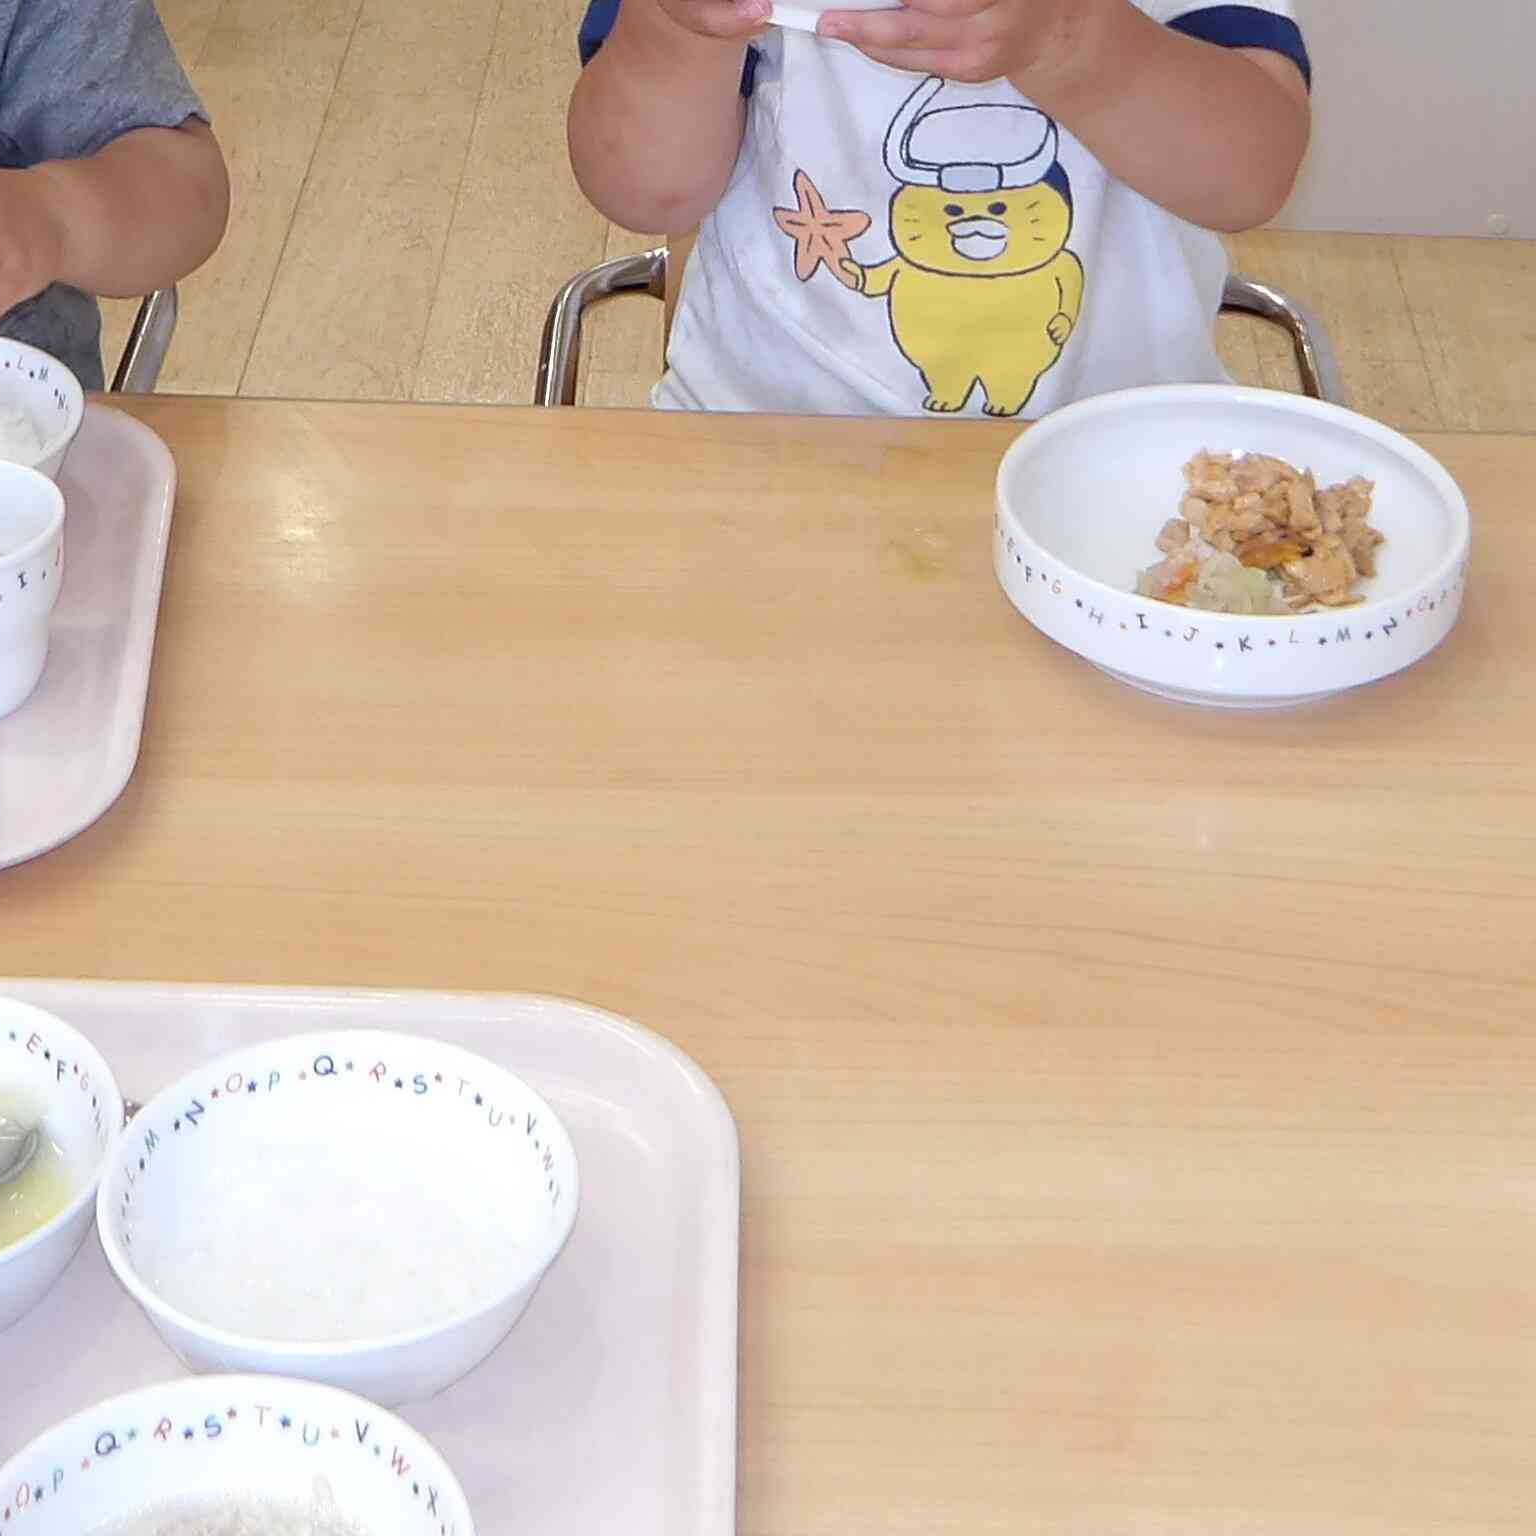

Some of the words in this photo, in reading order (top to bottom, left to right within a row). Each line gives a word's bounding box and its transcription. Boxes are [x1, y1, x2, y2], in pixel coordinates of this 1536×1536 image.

[16, 355, 26, 370] L
[38, 367, 48, 380] M
[1050, 579, 1064, 594] G
[1089, 608, 1103, 624] H
[1136, 613, 1148, 629] I
[1184, 627, 1199, 641] J
[1238, 635, 1253, 652] K
[1336, 627, 1351, 643] M
[1382, 617, 1398, 636] N
[26, 1033, 42, 1054] E
[144, 1129, 160, 1155] M
[184, 1099, 205, 1126] N
[225, 1072, 244, 1093] O
[268, 1070, 280, 1092] P
[313, 1054, 338, 1077] Q
[369, 1062, 386, 1083] R
[413, 1074, 428, 1095] S
[457, 1076, 471, 1096] T
[488, 1104, 503, 1127] U
[526, 1112, 538, 1135] V
[16, 1482, 31, 1509] O
[52, 1467, 64, 1493] P
[94, 1431, 121, 1456] Q
[154, 1417, 172, 1440] R
[204, 1414, 222, 1438] S
[255, 1404, 273, 1427] T
[303, 1424, 320, 1445] U
[355, 1419, 369, 1444] V
[391, 1446, 410, 1476] W
[427, 1486, 437, 1517] X
